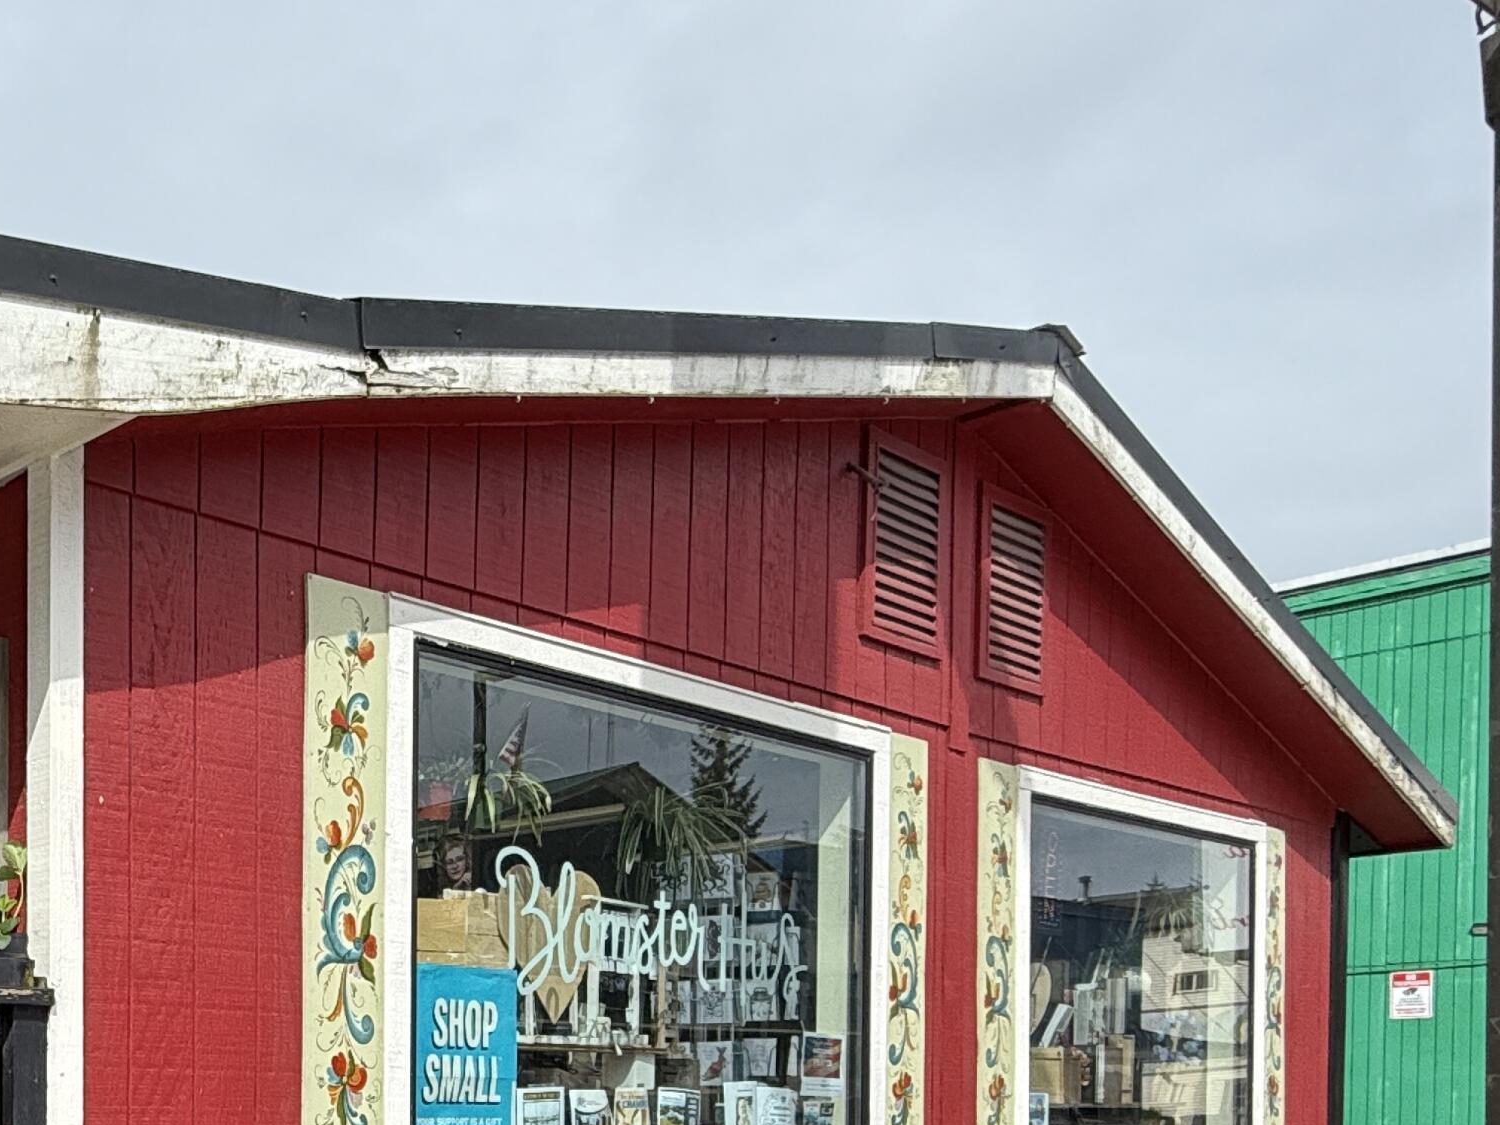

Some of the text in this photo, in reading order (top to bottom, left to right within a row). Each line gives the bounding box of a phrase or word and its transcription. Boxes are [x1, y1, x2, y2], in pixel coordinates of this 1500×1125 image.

[494, 845, 710, 995] Blomster
[432, 997, 499, 1049] SHOP
[422, 1053, 502, 1103] SMALL
